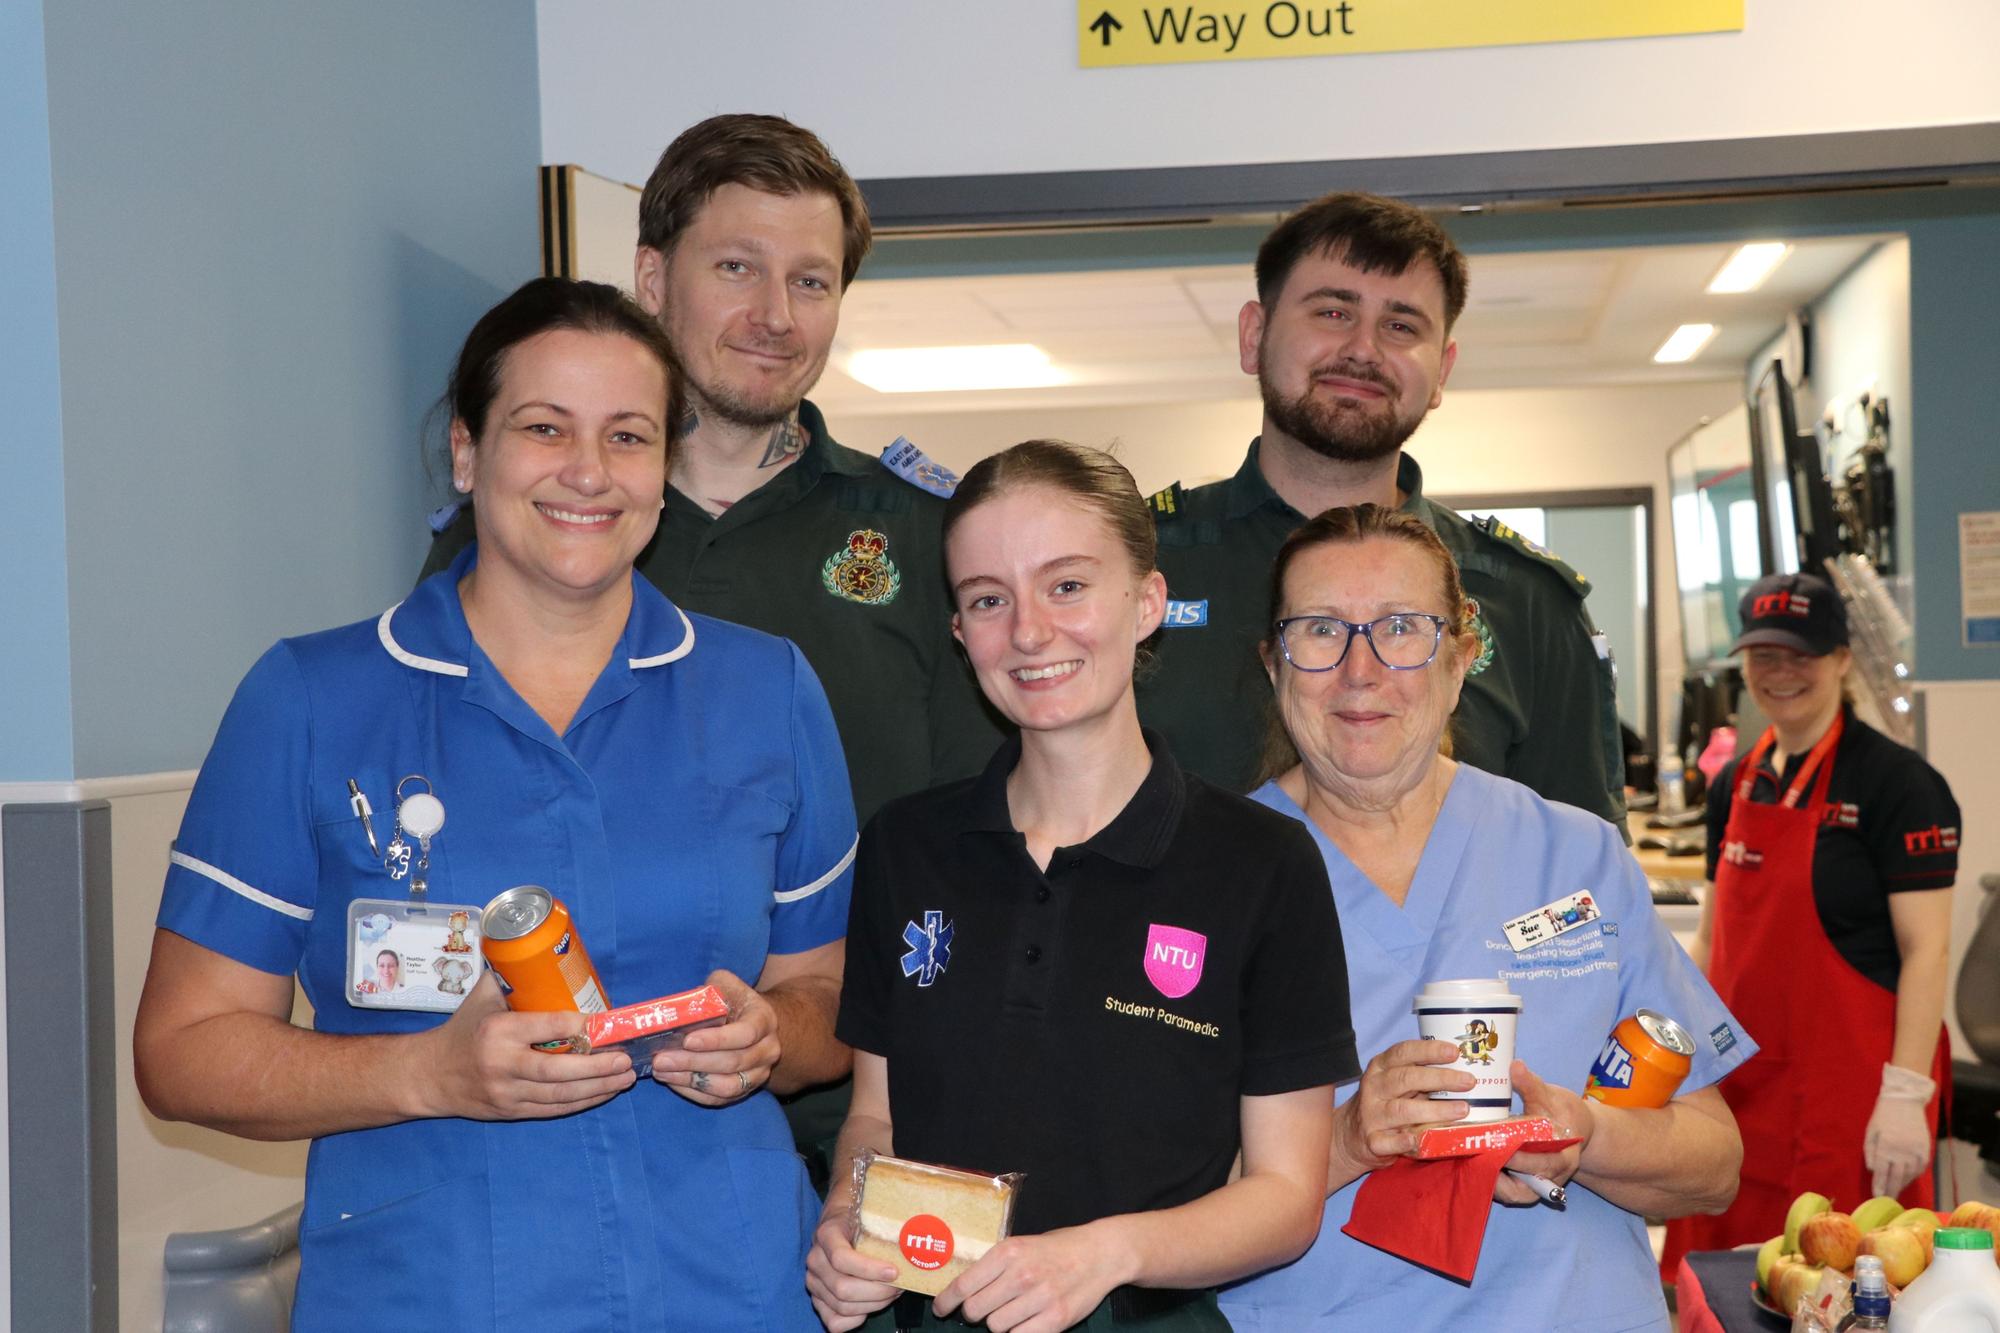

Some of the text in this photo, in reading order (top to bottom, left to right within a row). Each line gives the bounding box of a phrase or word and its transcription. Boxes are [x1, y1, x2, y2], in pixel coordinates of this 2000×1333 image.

[1143, 1, 1354, 52] Way Out
[1163, 602, 1201, 624] HS
[1904, 824, 1941, 852] rrt
[1153, 943, 1197, 970] NTU
[1560, 940, 1604, 957] Hospitals
[1498, 966, 1559, 980] Emergency
[634, 1006, 664, 1030] rrt
[1105, 996, 1219, 1037] Student Paramedic
[1465, 1131, 1492, 1149] rrt
[907, 1234, 934, 1250] rrt
[911, 1256, 940, 1268] VICTORIA
